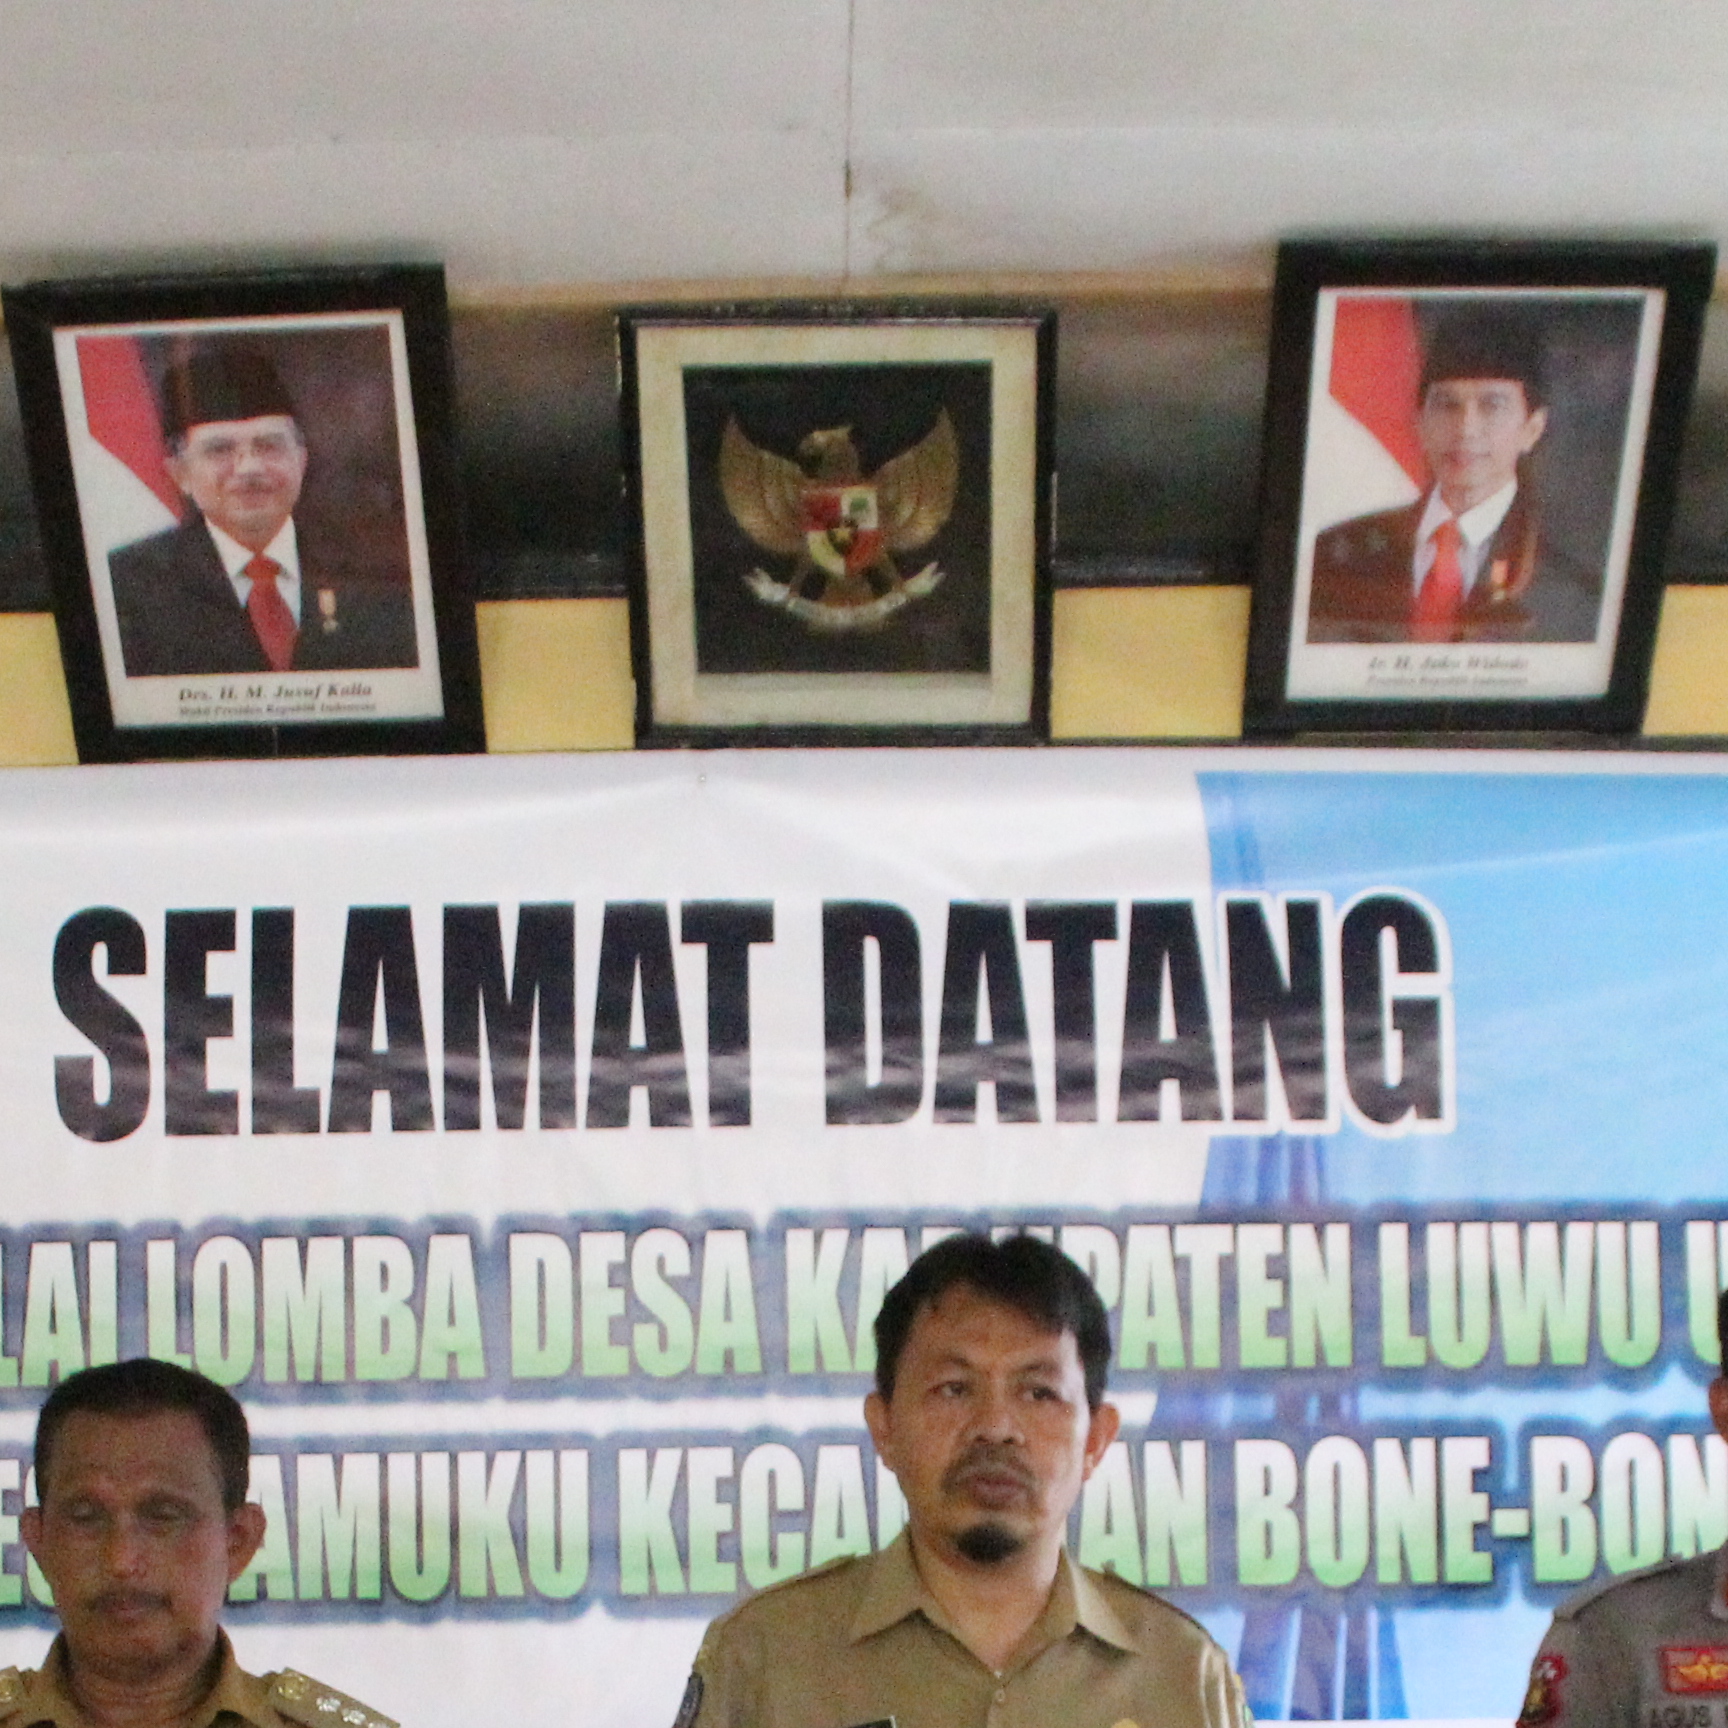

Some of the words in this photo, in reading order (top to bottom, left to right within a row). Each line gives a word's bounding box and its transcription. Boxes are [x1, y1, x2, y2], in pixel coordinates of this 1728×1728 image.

[51, 898, 775, 1144] SELAMAT
[820, 894, 1442, 1126] DATANG
[145, 1233, 486, 1387] LOMBA
[508, 1227, 763, 1379] DESA
[785, 1222, 1353, 1376] KAPATEN
[1380, 1218, 1662, 1370] LUWU
[225, 1446, 589, 1602] AMUKU
[617, 1440, 1208, 1597] KECAAN
